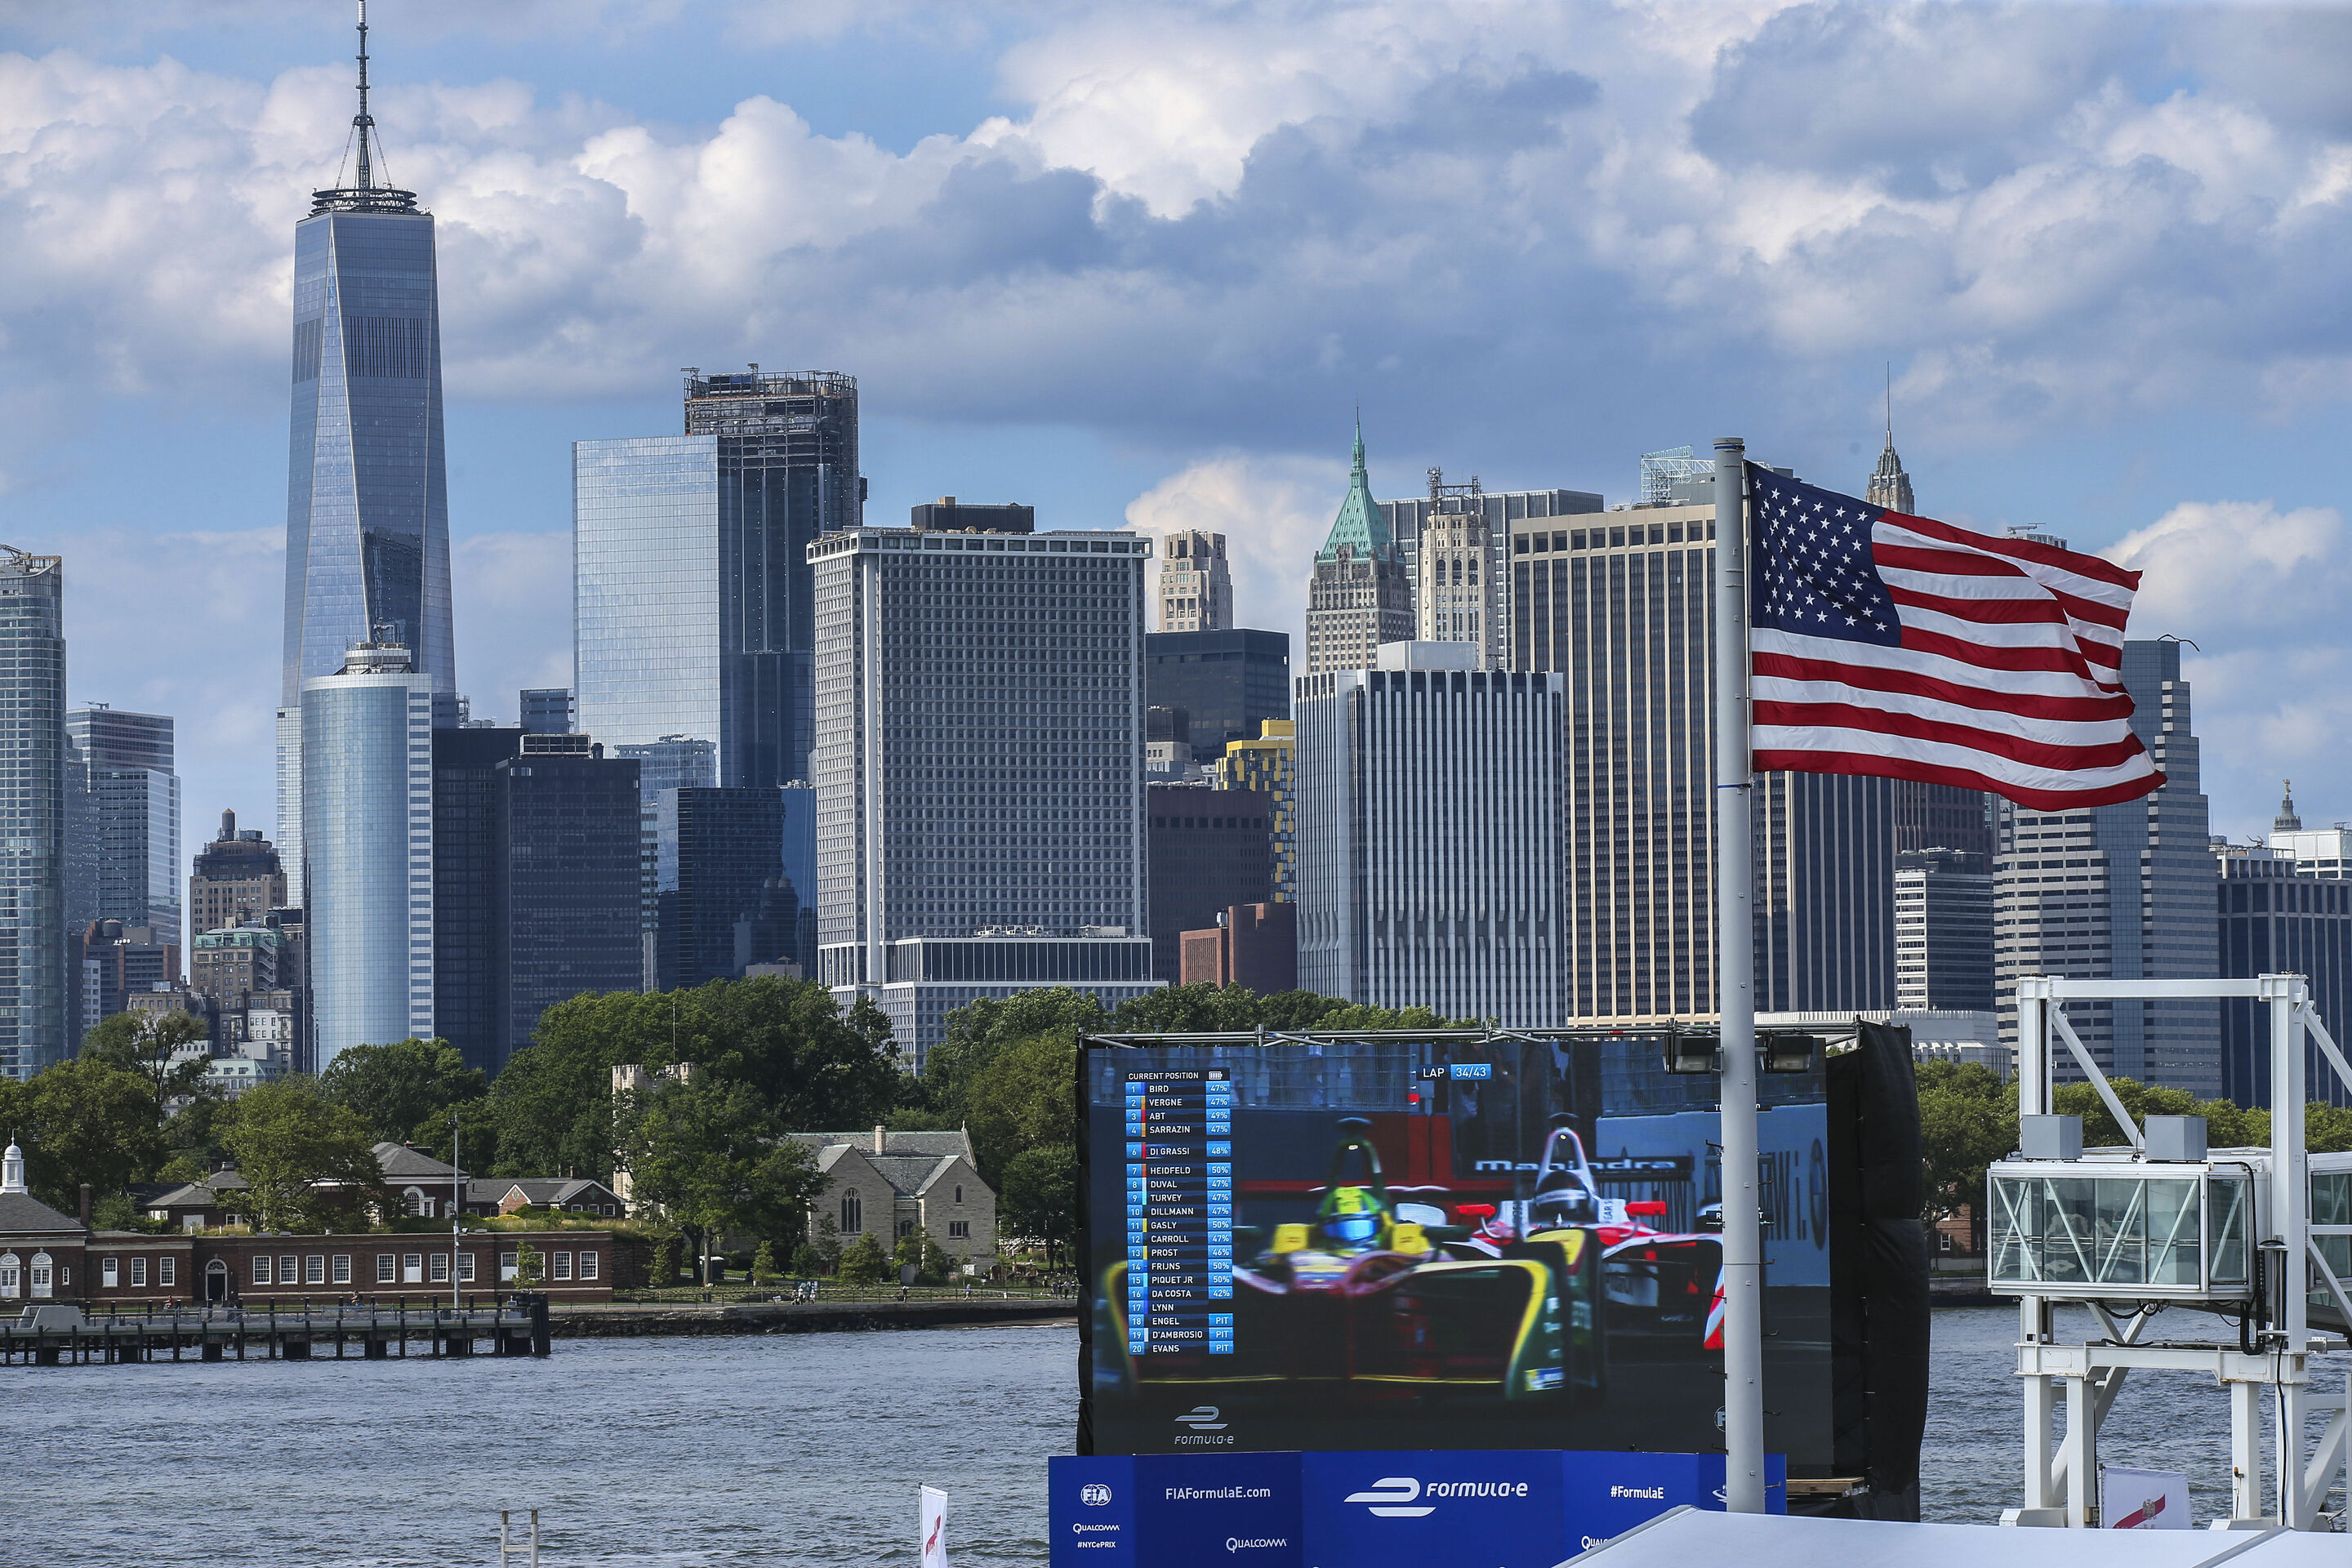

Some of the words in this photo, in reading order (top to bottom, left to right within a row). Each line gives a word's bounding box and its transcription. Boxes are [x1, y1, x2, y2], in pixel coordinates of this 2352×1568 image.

[1128, 1072, 1165, 1080] CURRENT
[1165, 1071, 1199, 1080] POSITION
[1423, 1067, 1445, 1078] LAP
[1454, 1065, 1486, 1078] 34/43
[1149, 1085, 1169, 1093] BIRD
[1210, 1084, 1227, 1092] 47%
[1131, 1098, 1137, 1107] 2
[1148, 1098, 1183, 1107] VERGNE
[1209, 1098, 1227, 1106] 47%
[1131, 1112, 1137, 1120] 3
[1149, 1111, 1165, 1120] ABT
[1210, 1111, 1228, 1120] 49%
[1131, 1126, 1137, 1134] 4
[1149, 1125, 1191, 1134] SARRAZIN
[1210, 1125, 1228, 1133] 47%
[1150, 1147, 1159, 1156] DI
[1160, 1147, 1190, 1156] GRASSI
[1211, 1147, 1228, 1155] 48%
[1132, 1167, 1138, 1175] 7
[1150, 1166, 1191, 1174] HEIDFELD
[1211, 1165, 1228, 1174] 50%
[1132, 1181, 1138, 1189] 8
[1150, 1180, 1178, 1188] DUVAL
[1211, 1179, 1229, 1187] 47%
[1132, 1194, 1138, 1202] 9
[1150, 1194, 1183, 1202] TURVEY
[1211, 1193, 1229, 1201] 47%
[1131, 1208, 1140, 1216] 10
[1151, 1207, 1194, 1216] DILLMANN
[1212, 1206, 1230, 1215] 47%
[1130, 1222, 1139, 1230] 11
[1151, 1221, 1177, 1229] GASLY
[1212, 1220, 1229, 1228] 50%
[1131, 1235, 1140, 1244] 12
[1151, 1235, 1189, 1243] CARROLL
[1212, 1234, 1230, 1242] 47%
[1131, 1249, 1141, 1257] 13
[1152, 1248, 1178, 1257] PROST
[1212, 1248, 1230, 1256] 46%
[1131, 1263, 1141, 1271] 14
[1152, 1262, 1181, 1271] FRIJNS
[1213, 1261, 1230, 1270] 50%
[1132, 1276, 1141, 1285] 15
[1152, 1276, 1182, 1284] PIQUET
[1183, 1276, 1193, 1284] JR
[1213, 1275, 1231, 1283] 50%
[1132, 1290, 1141, 1298] 16
[1152, 1290, 1164, 1298] DA
[1165, 1290, 1192, 1298] COSTA
[1213, 1289, 1231, 1297] 42%
[1132, 1303, 1142, 1312] 17
[1152, 1303, 1174, 1312] LYNN
[1132, 1317, 1142, 1325] 18
[1152, 1317, 1180, 1325] ENGEL
[1215, 1316, 1229, 1325] PIT
[1132, 1331, 1142, 1339] 19
[1152, 1330, 1203, 1339] D'AMBROSIO
[1215, 1330, 1229, 1339] PIT
[1132, 1345, 1142, 1353] 20
[1152, 1344, 1180, 1352] EVANS
[1216, 1343, 1229, 1352] PIT
[1166, 1487, 1271, 1500] FIAFormulaE.com
[1611, 1486, 1664, 1499] #FormulaE
